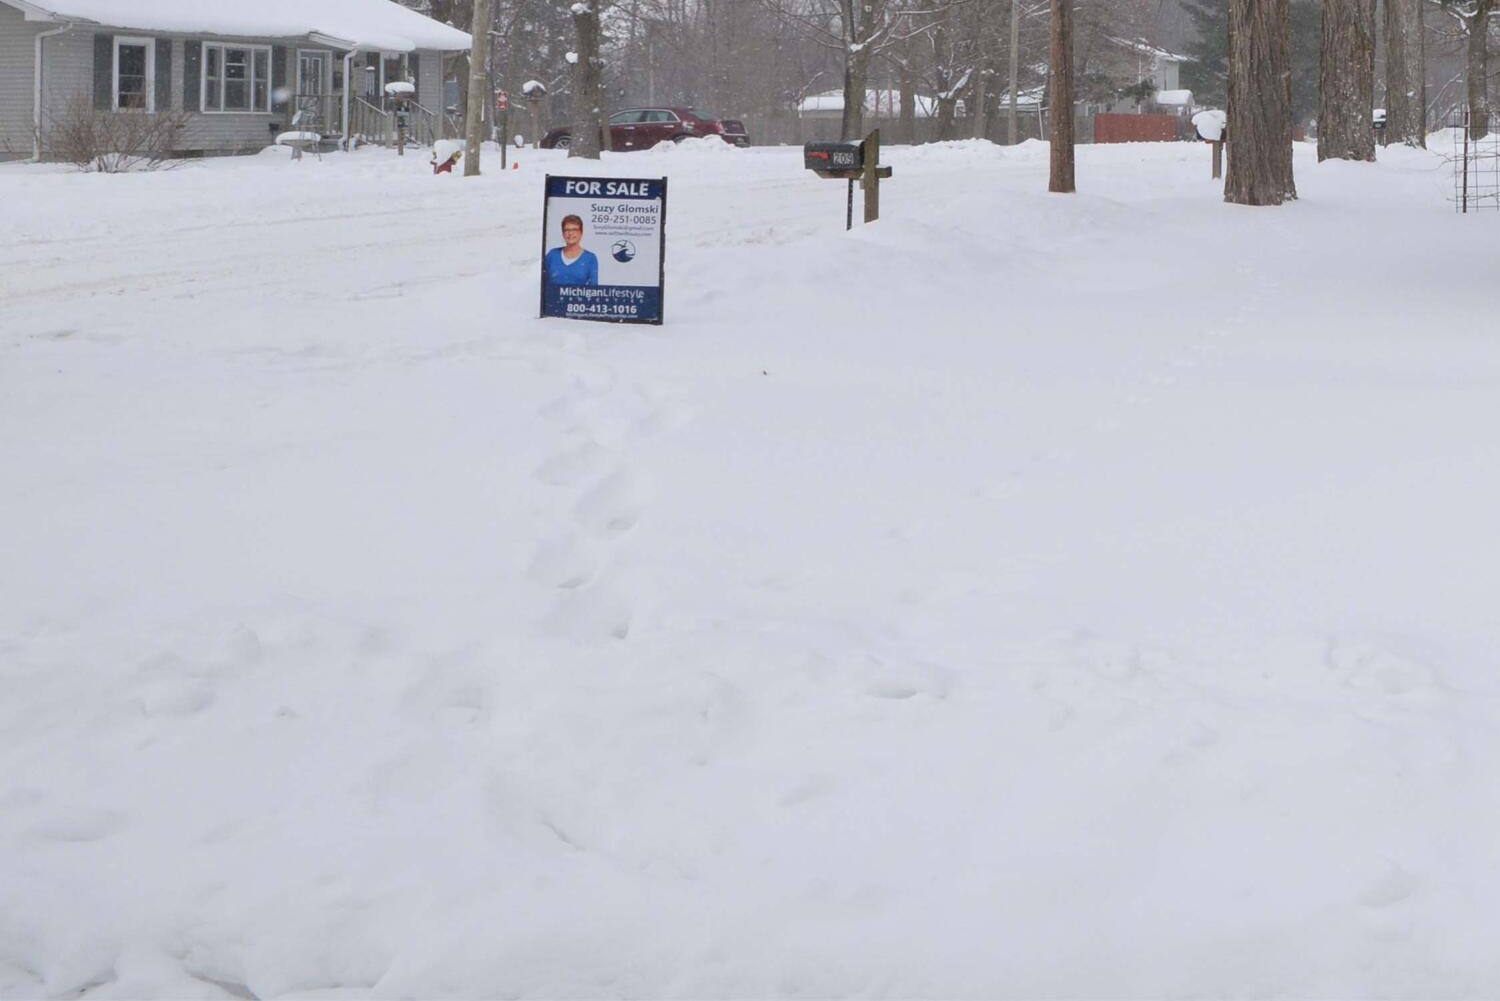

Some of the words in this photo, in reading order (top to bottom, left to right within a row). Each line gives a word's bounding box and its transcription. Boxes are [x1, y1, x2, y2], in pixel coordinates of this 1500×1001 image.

[566, 181, 602, 195] FOR
[606, 182, 649, 196] SALE
[591, 203, 615, 214] Suzy
[617, 204, 659, 214] Glomski
[591, 214, 657, 225] 269-251-0085
[566, 303, 637, 314] 800-413-1016
